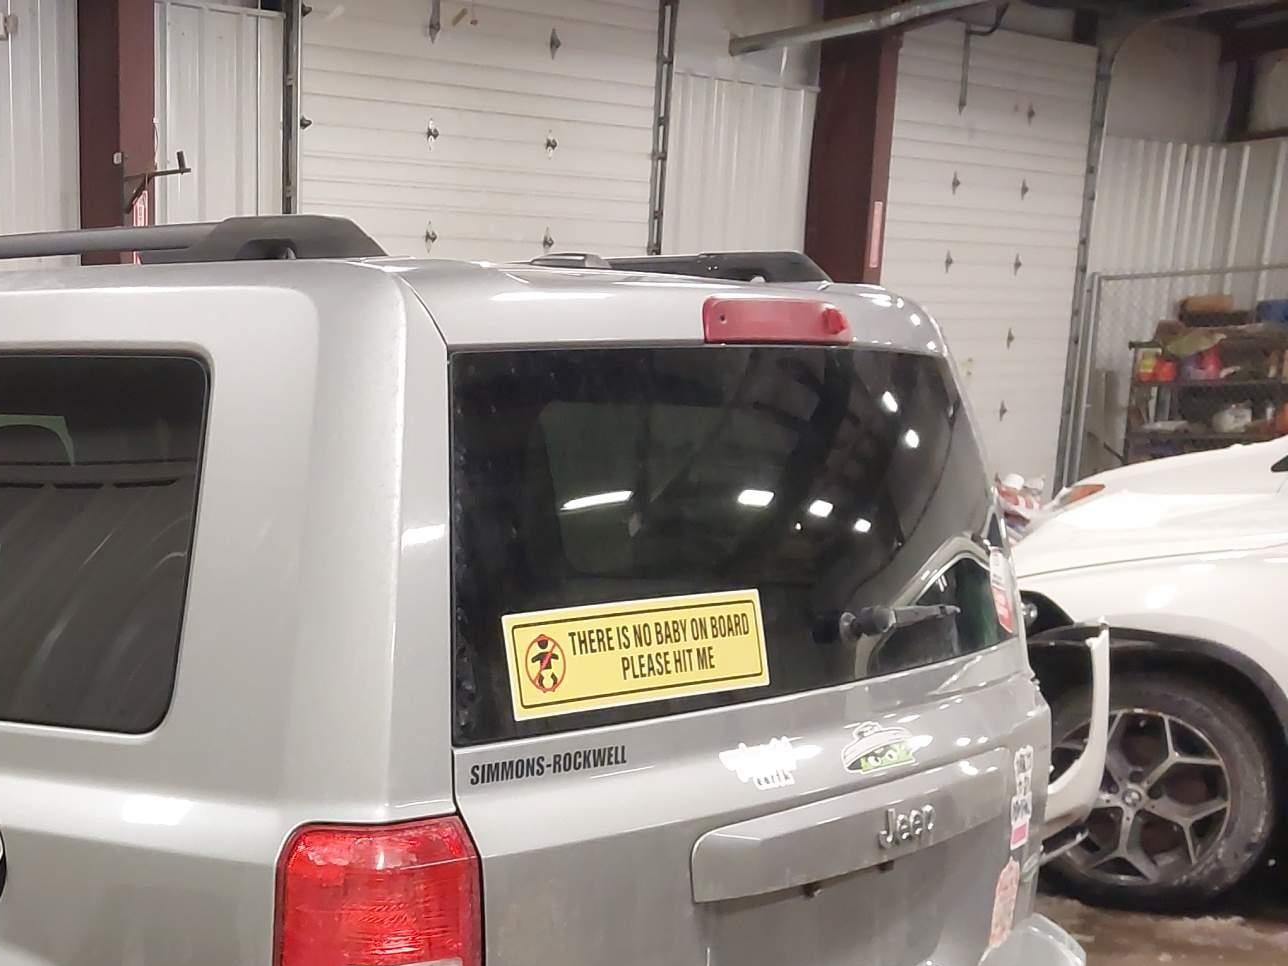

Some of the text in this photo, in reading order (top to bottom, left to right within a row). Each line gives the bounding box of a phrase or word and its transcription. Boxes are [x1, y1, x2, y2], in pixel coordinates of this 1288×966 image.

[568, 613, 750, 655] THERE IS NO BABY ON BOARD
[622, 646, 716, 681] PLEASE HIT ME
[470, 745, 627, 785] SIMMONS-ROCKWELL
[879, 804, 936, 849] Jeep
